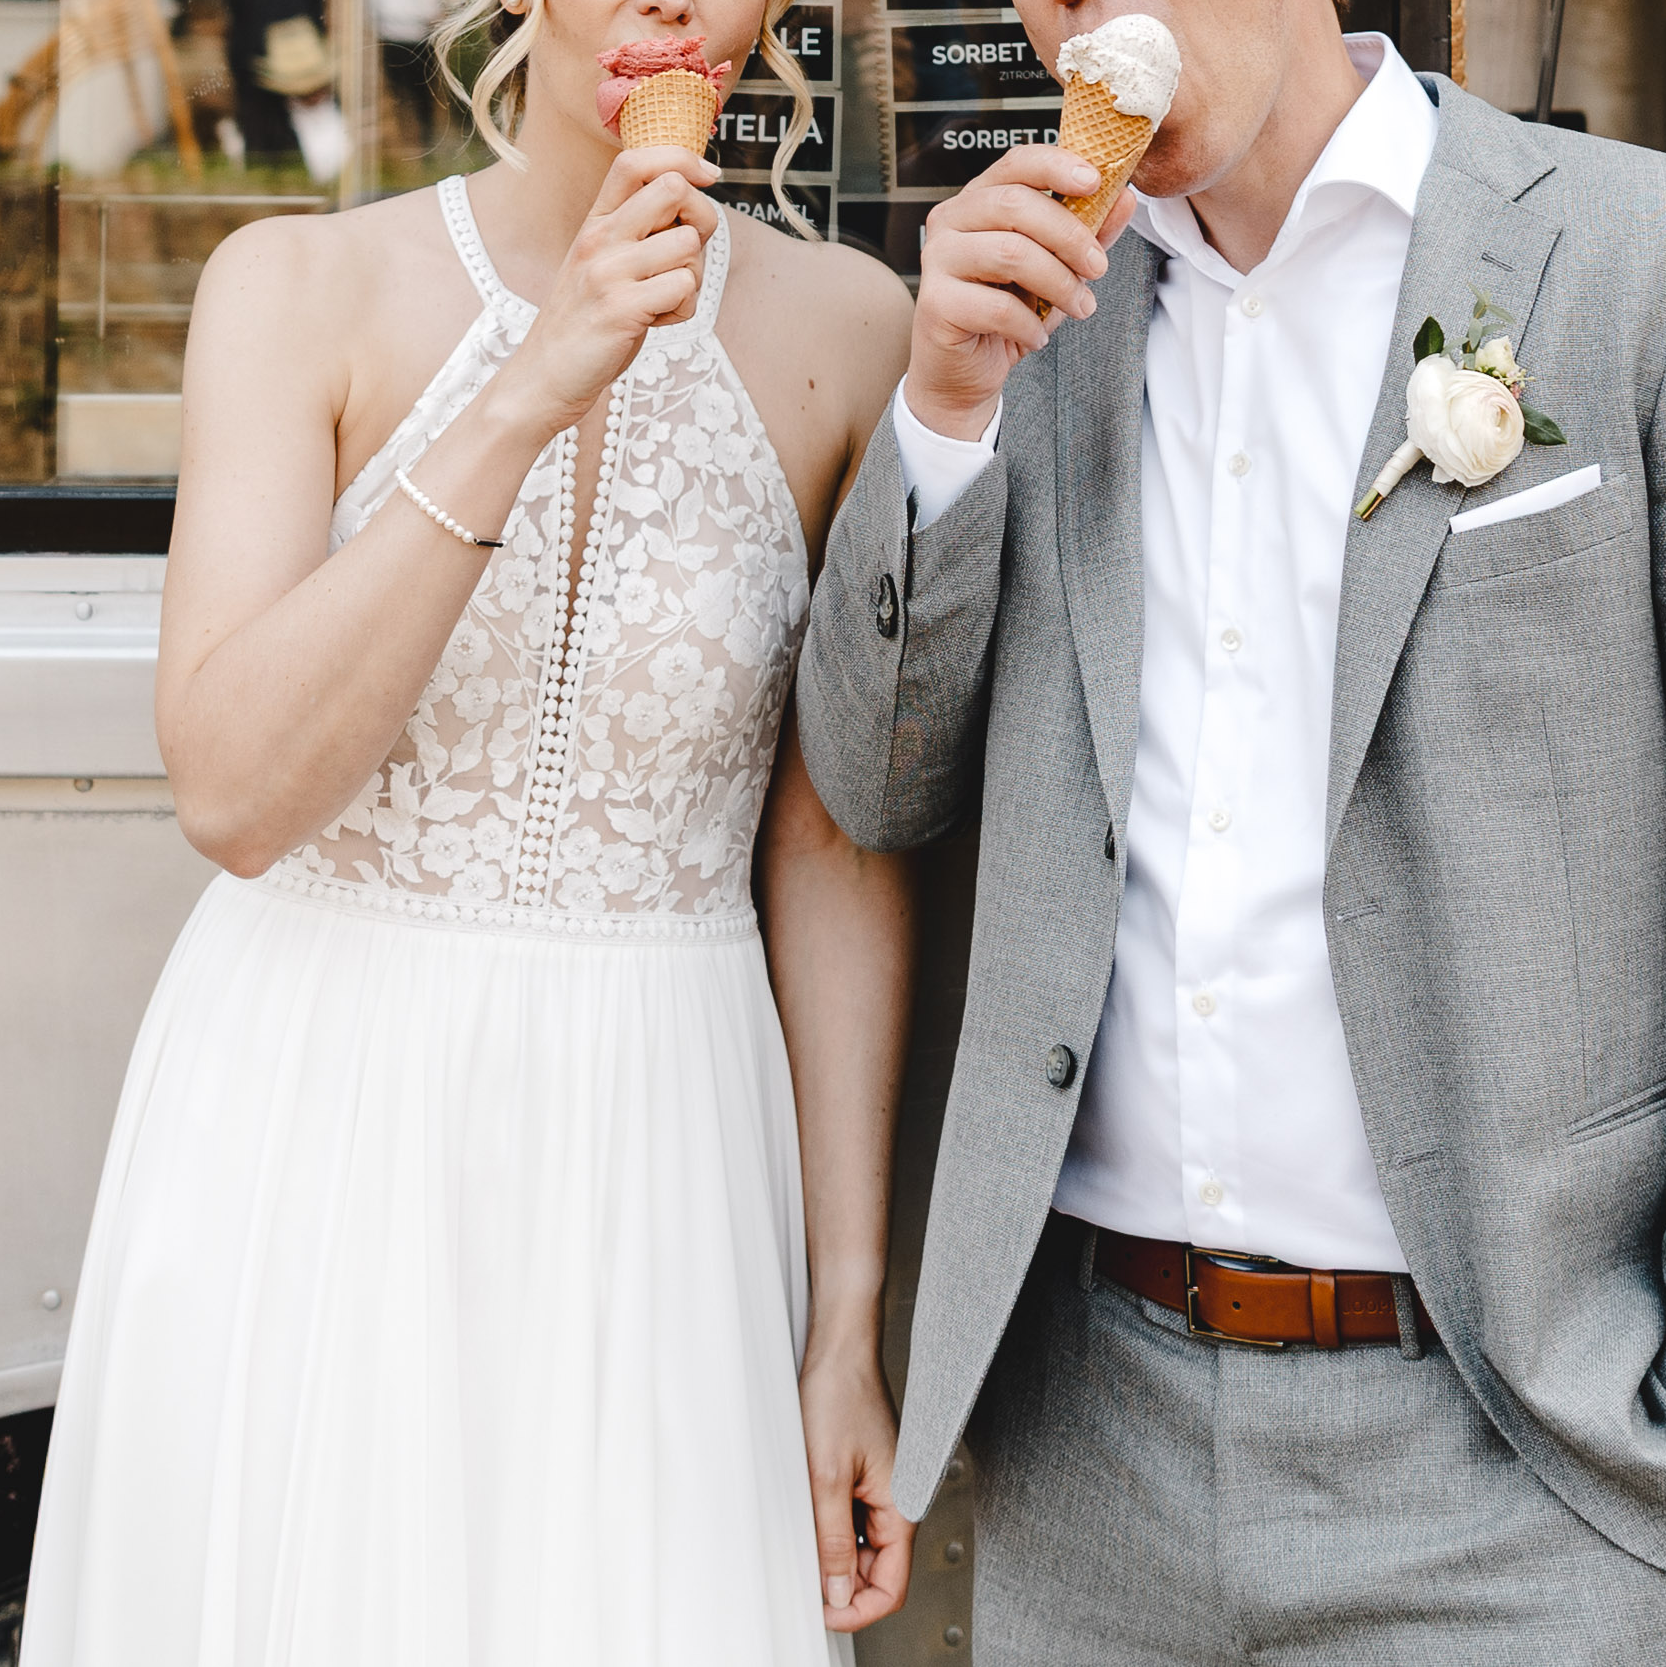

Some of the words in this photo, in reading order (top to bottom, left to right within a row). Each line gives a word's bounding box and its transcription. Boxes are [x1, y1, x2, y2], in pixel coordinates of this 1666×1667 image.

[932, 42, 1027, 65] SORBET
[709, 113, 824, 145] TELLA
[942, 128, 1038, 150] SORBET
